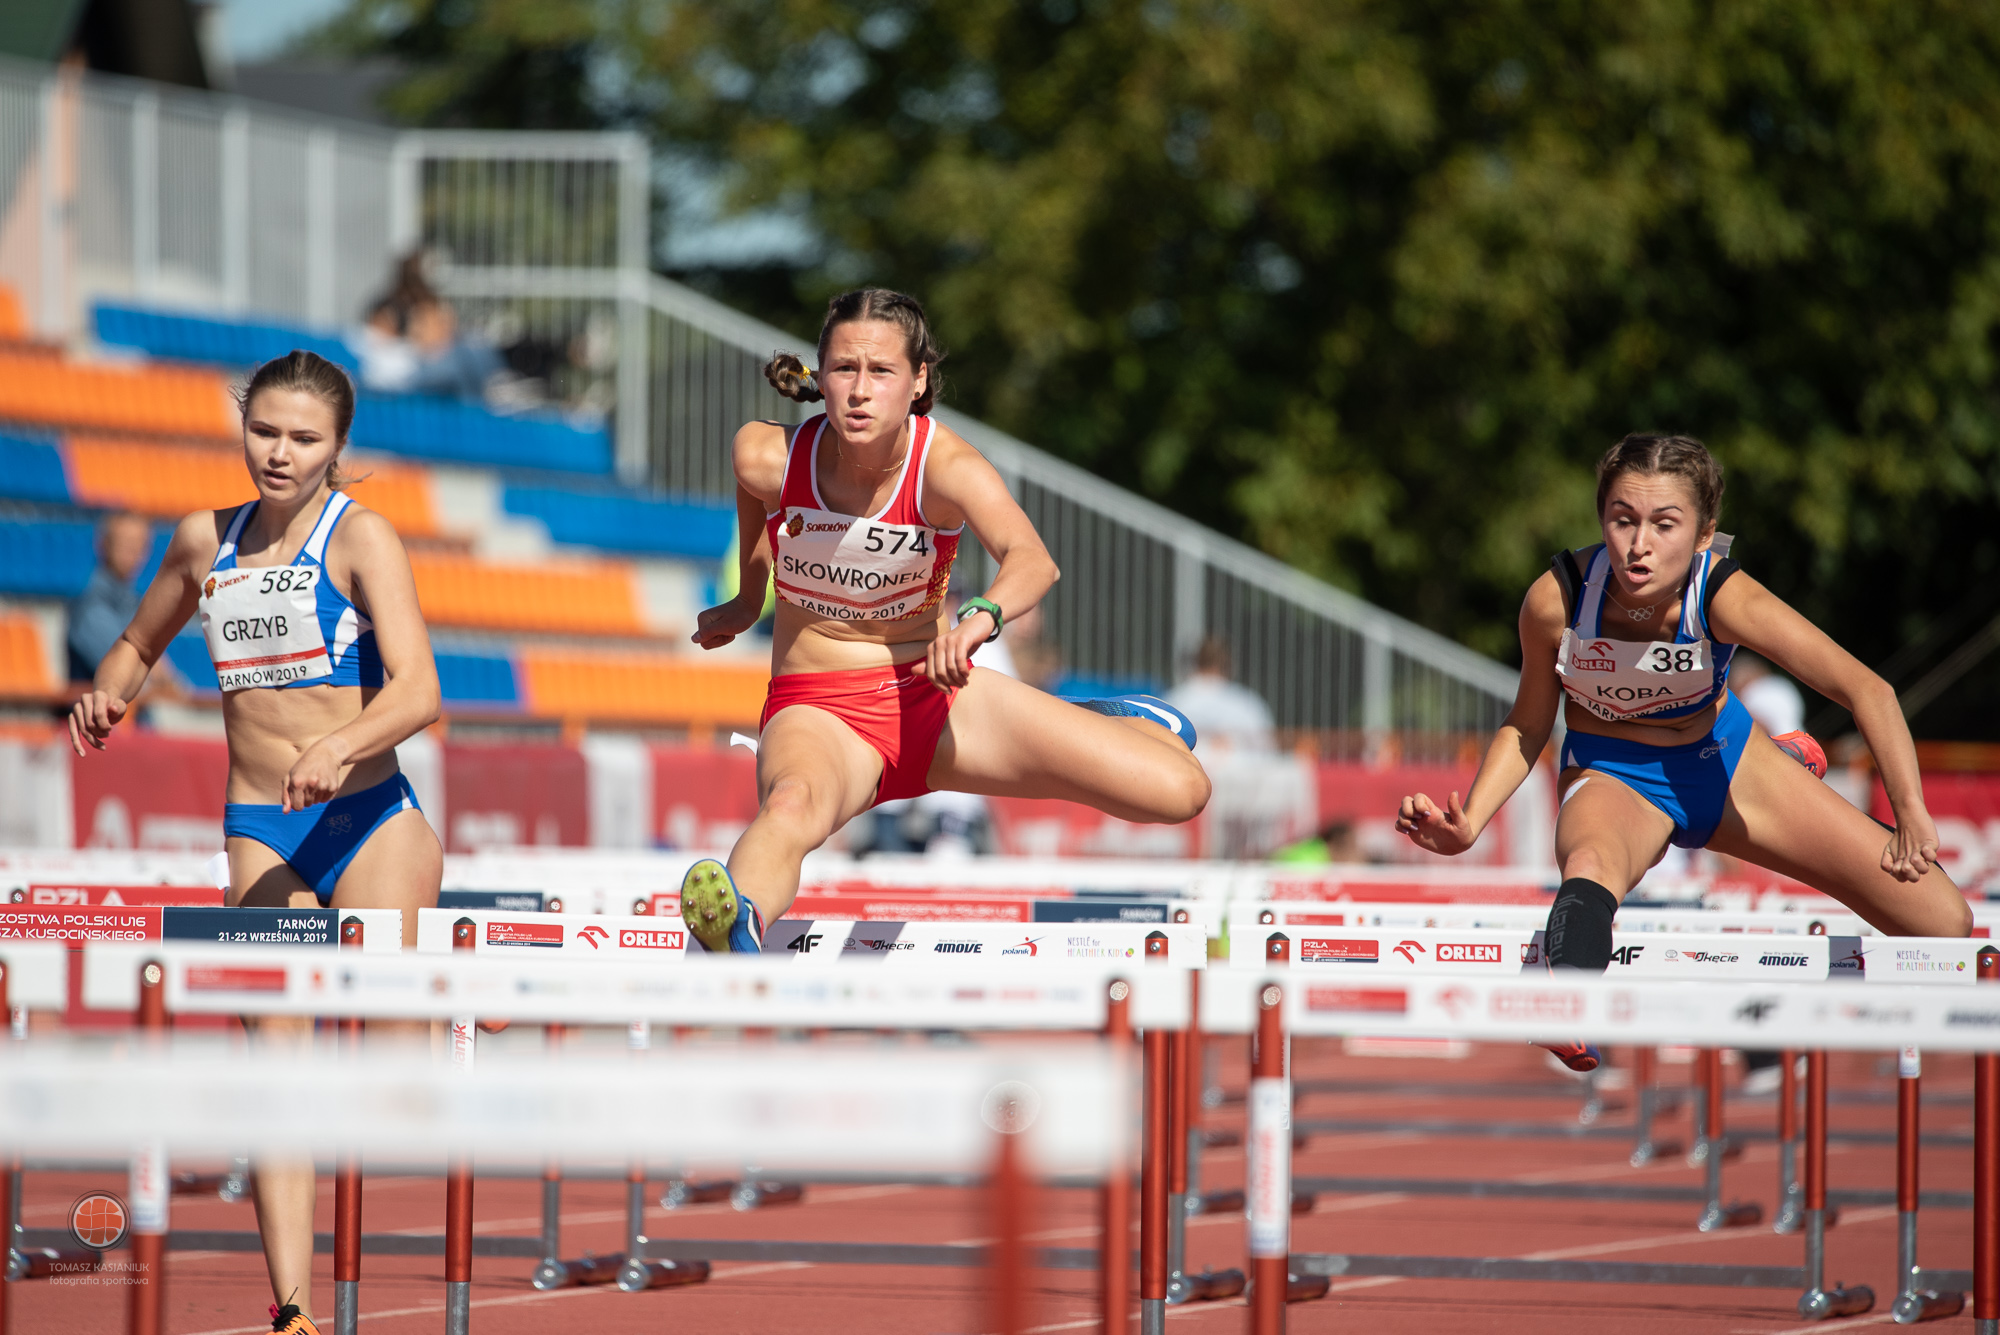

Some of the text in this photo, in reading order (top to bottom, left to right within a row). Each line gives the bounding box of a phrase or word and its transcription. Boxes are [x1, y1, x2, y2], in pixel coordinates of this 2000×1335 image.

[864, 526, 929, 557] 574
[783, 555, 927, 590] SKOWRONEK
[260, 570, 313, 594] 582
[800, 598, 866, 619] TARNÓW
[871, 602, 905, 619] 2019
[223, 615, 288, 641] GRZYB
[1573, 656, 1613, 671] ORLEN
[1652, 647, 1693, 672] 38
[220, 665, 307, 688] TARNÓW 2019
[1596, 685, 1674, 701] KOBA
[63, 914, 117, 926] POLSKI
[120, 916, 146, 927] U16
[277, 916, 328, 930] TARNÓW
[25, 928, 146, 941] KUSOCIŃSKIEGO
[218, 930, 328, 943] 21-22 WRZEŚNIA 2019
[622, 932, 680, 948] ORLEN
[786, 934, 823, 953] 4F
[1092, 939, 1101, 947] for
[1304, 941, 1328, 949] PZLA
[1067, 948, 1124, 958] HEALTHIER KIDS
[1439, 945, 1498, 961] ORLEN
[1610, 946, 1645, 965] 4F
[1896, 961, 1955, 972] HEALTHIER KIDS
